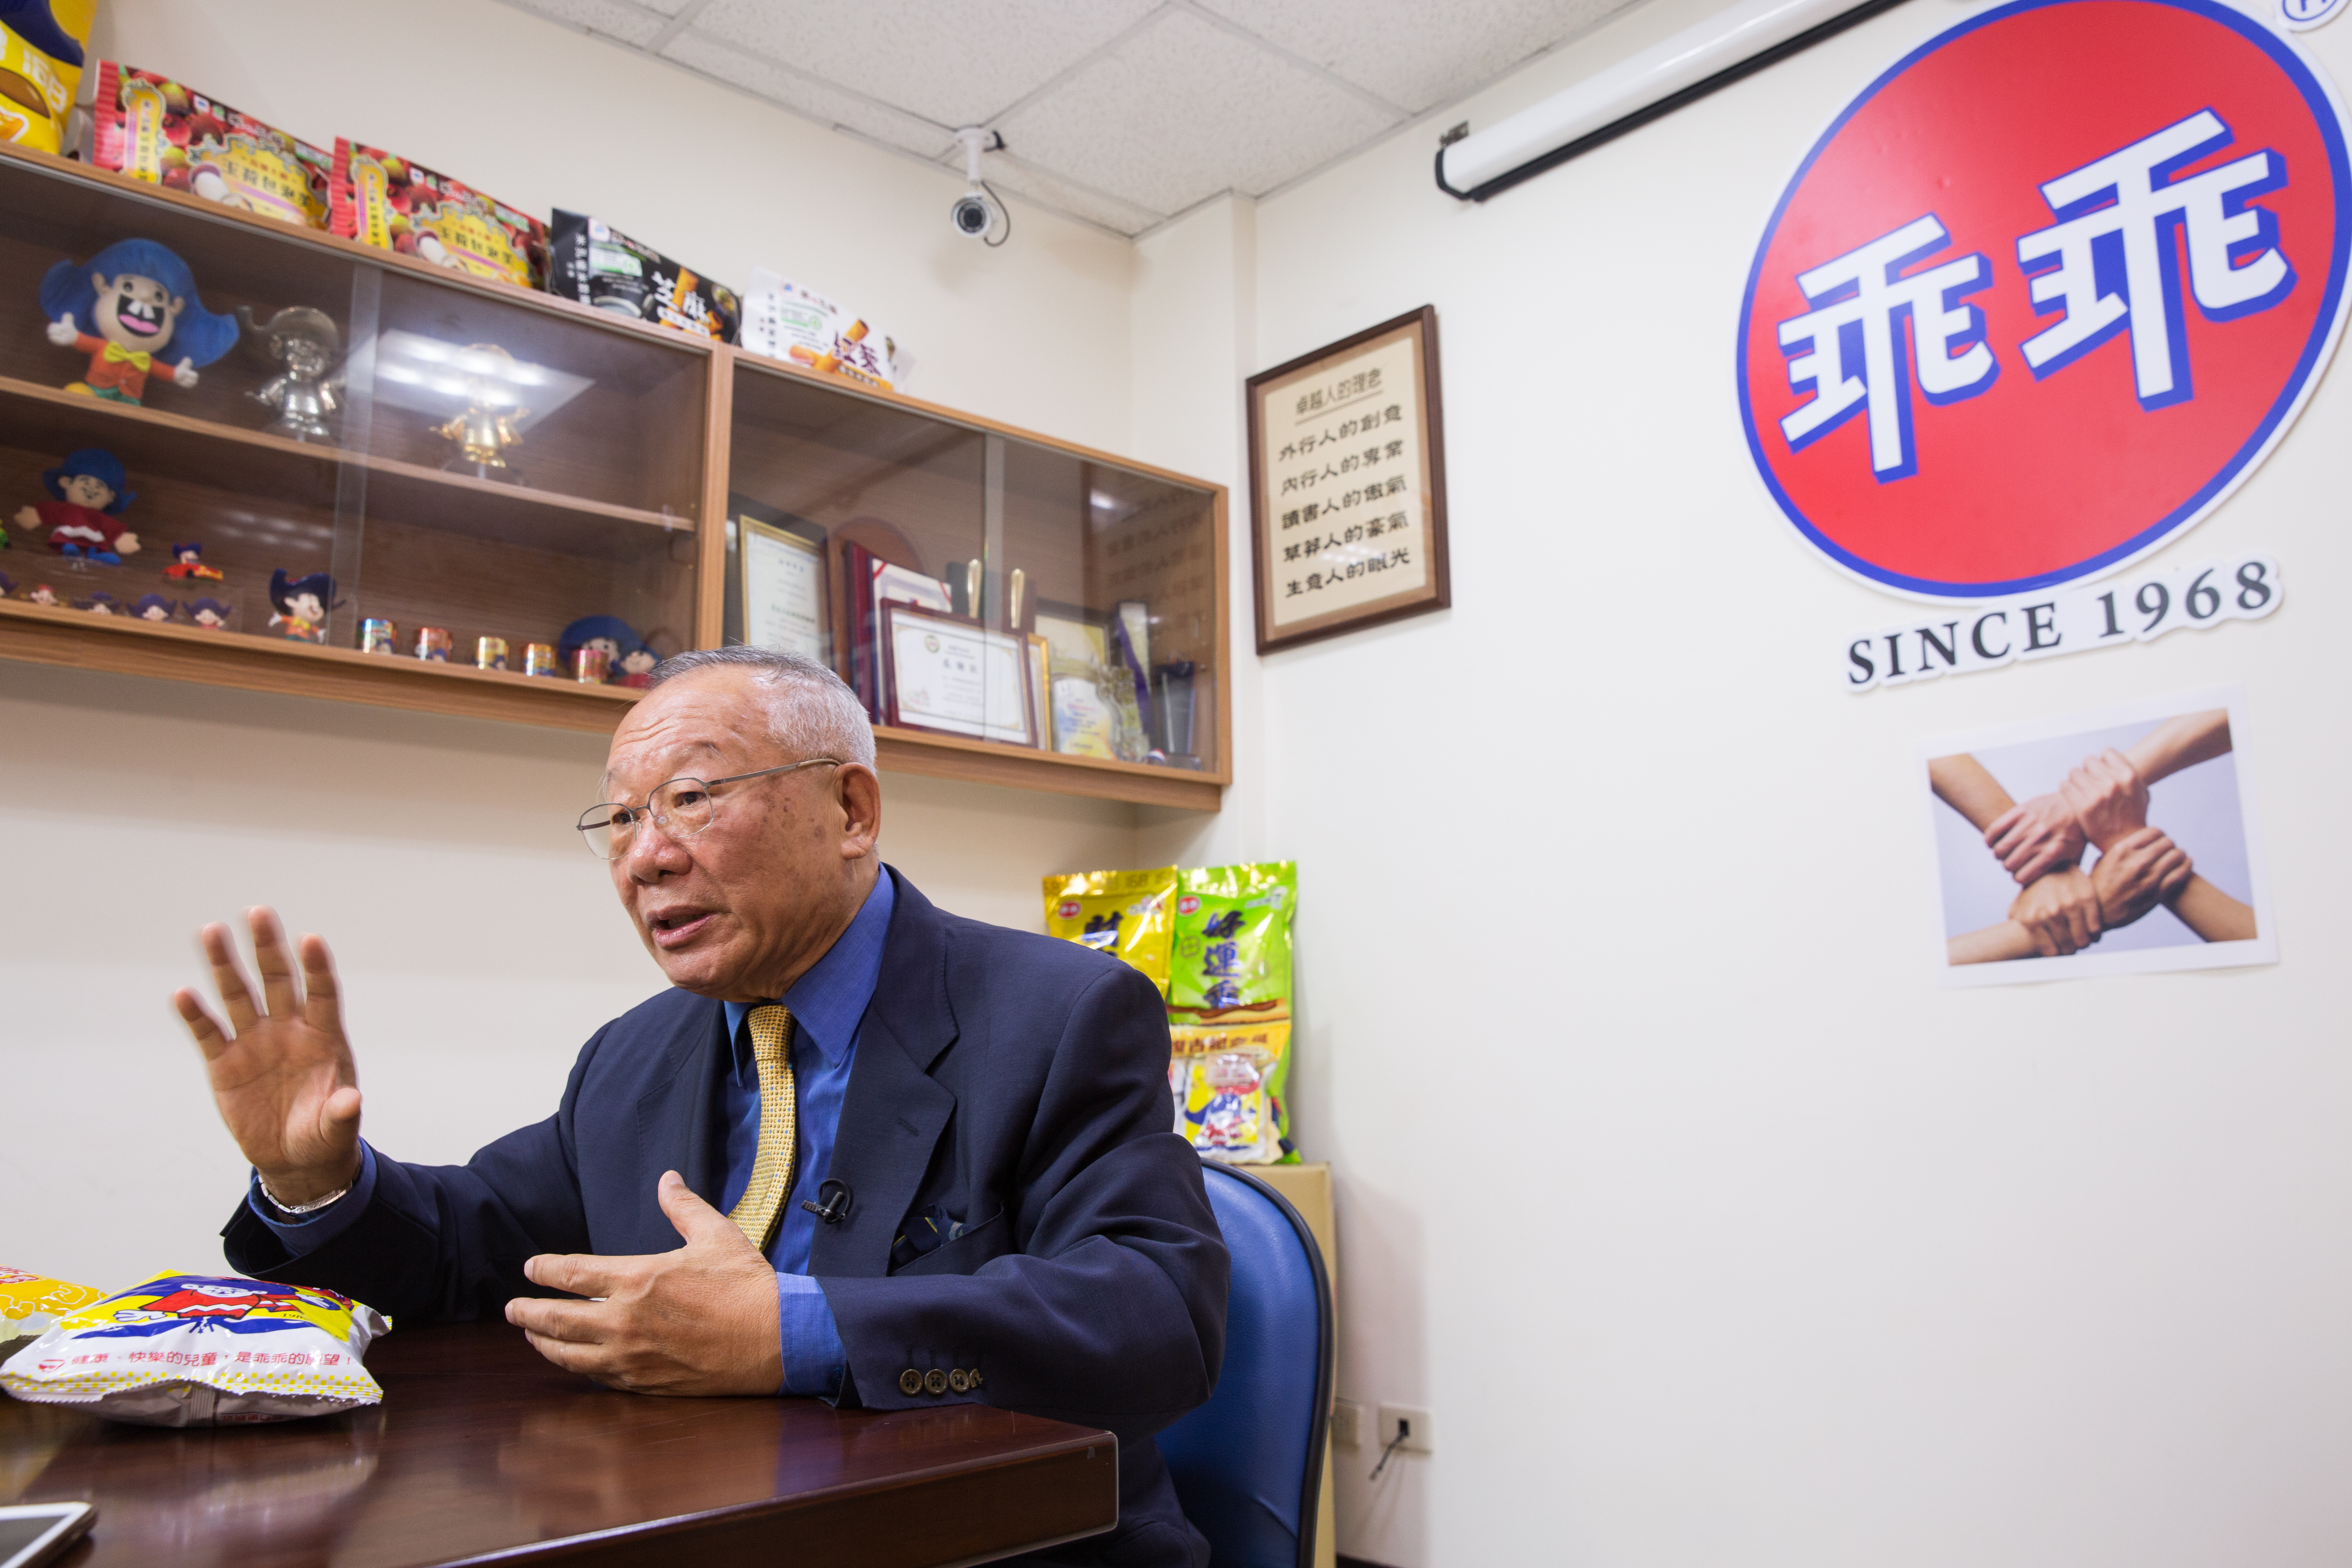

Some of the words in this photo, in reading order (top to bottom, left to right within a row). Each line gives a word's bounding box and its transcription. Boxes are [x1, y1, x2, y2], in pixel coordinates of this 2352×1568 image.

[1777, 105, 2298, 485] 乖乖
[1279, 404, 1402, 462] 外行人的創意
[1296, 368, 1382, 415] 卓越人的理念
[1848, 602, 2061, 684] SINCE
[2096, 561, 2272, 638] 1968
